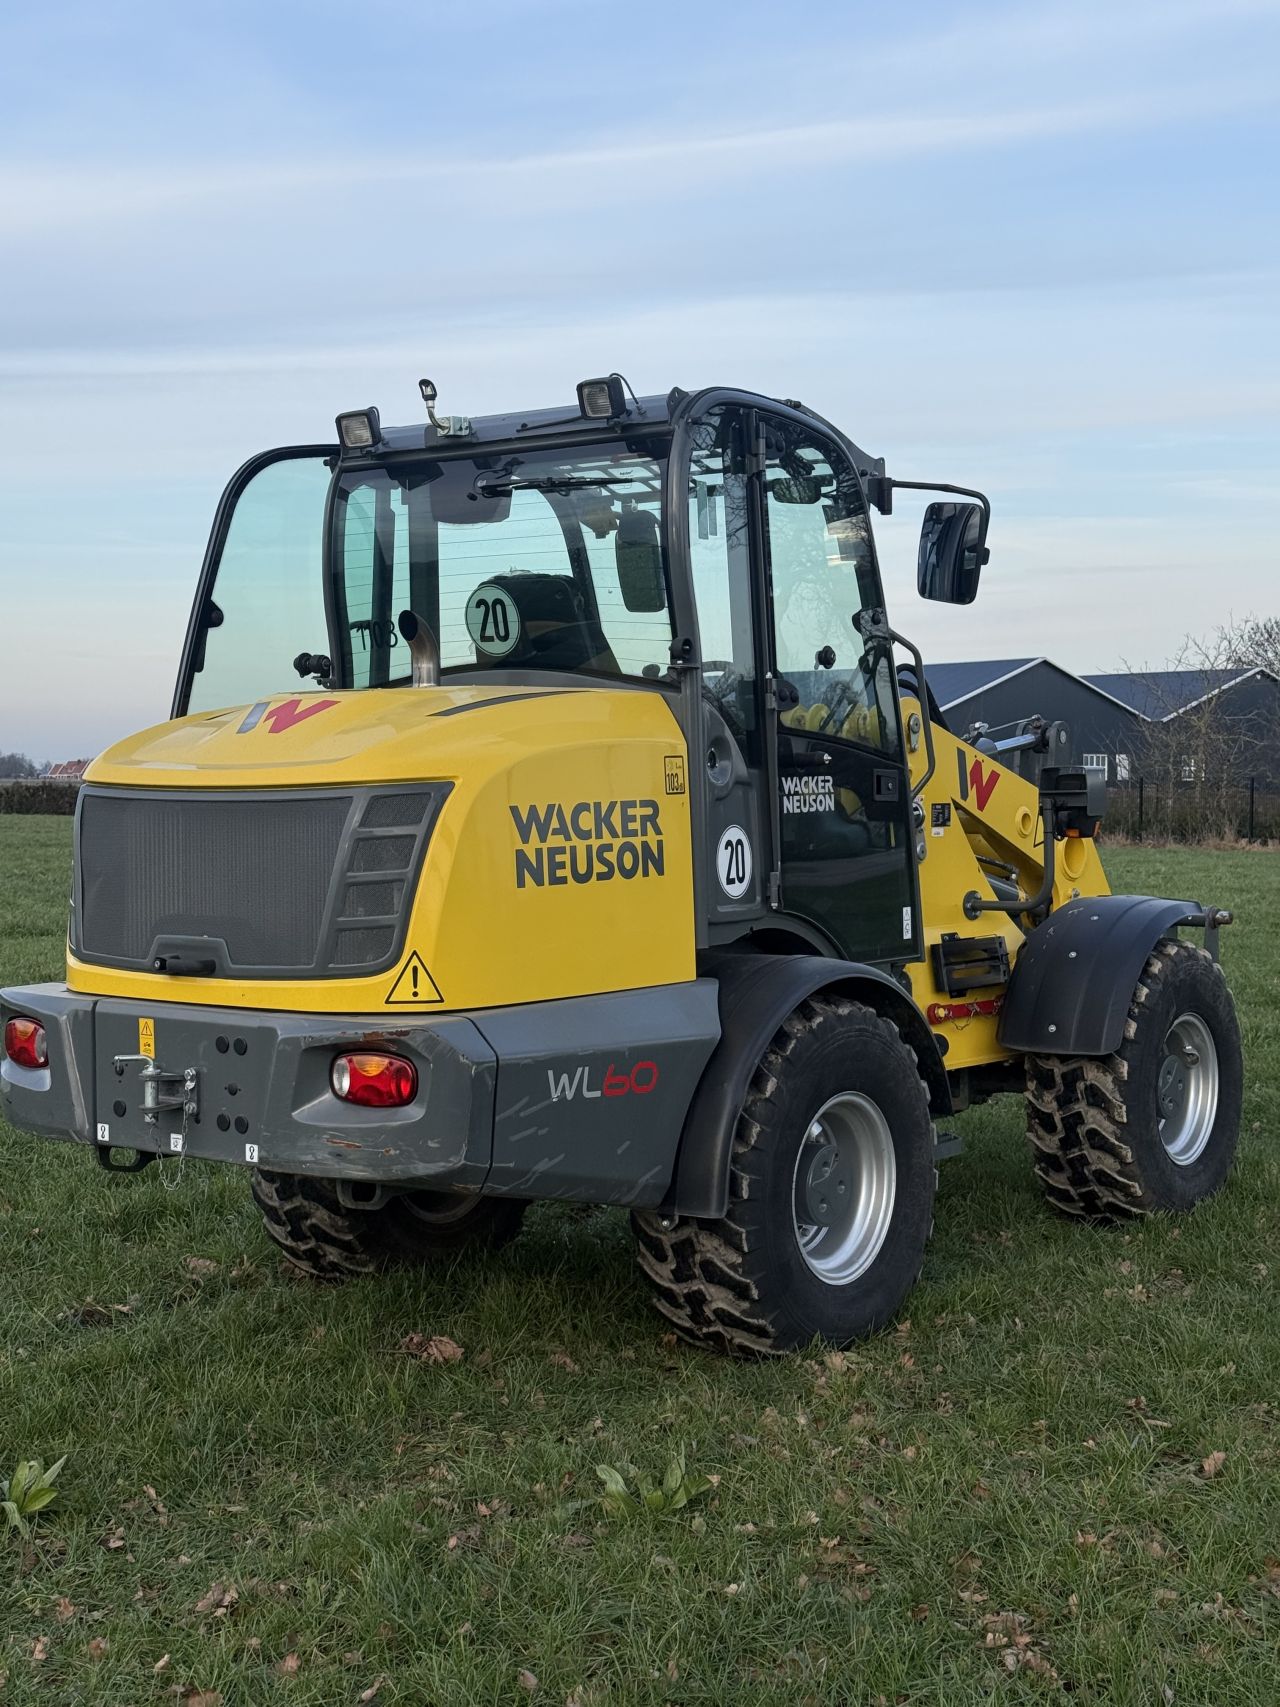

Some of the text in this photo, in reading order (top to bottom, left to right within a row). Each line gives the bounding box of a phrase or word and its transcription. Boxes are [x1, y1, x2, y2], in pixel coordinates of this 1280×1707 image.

[475, 597, 510, 643] 20
[781, 775, 835, 795] WACKER
[783, 793, 835, 814] NEUSON
[508, 799, 664, 845] WACKER
[515, 839, 665, 889] NEUSON
[724, 838, 746, 886] 20
[547, 1060, 659, 1102] WL60
